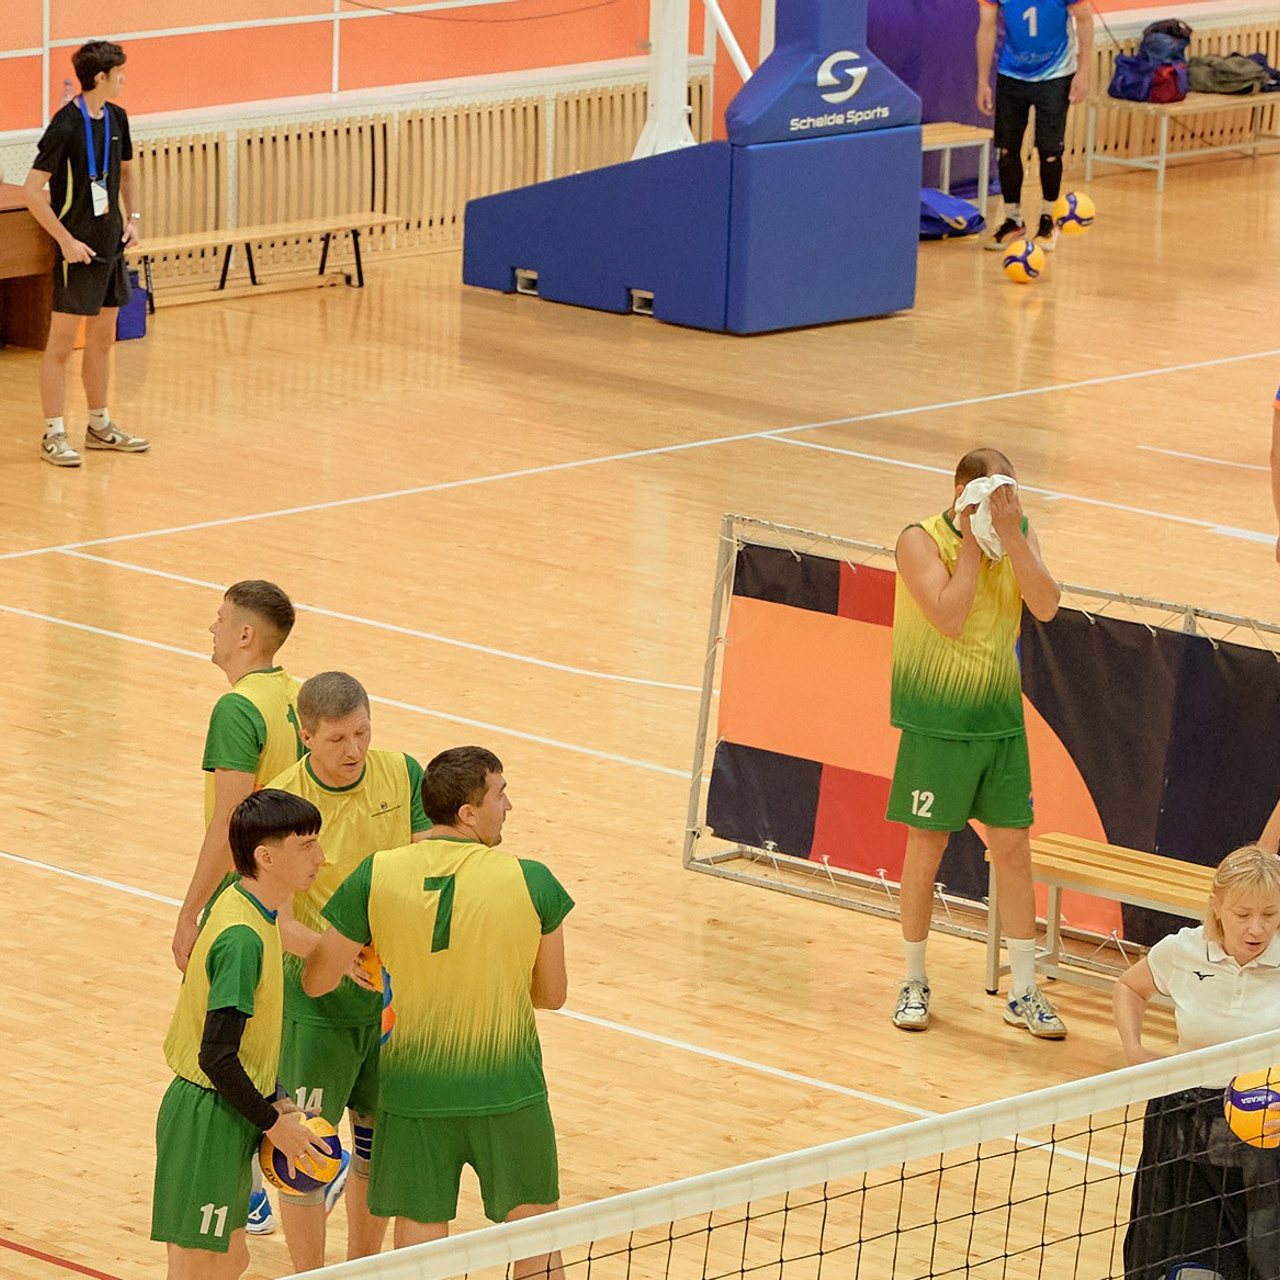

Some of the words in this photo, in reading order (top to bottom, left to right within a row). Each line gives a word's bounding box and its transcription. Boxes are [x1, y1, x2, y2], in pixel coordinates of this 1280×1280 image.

[1022, 6, 1038, 37] 1
[789, 112, 845, 131] Schelde
[846, 106, 890, 126] Sports
[911, 789, 935, 818] 12
[423, 873, 456, 954] 7
[295, 1086, 324, 1116] 14
[200, 1203, 229, 1238] 11
